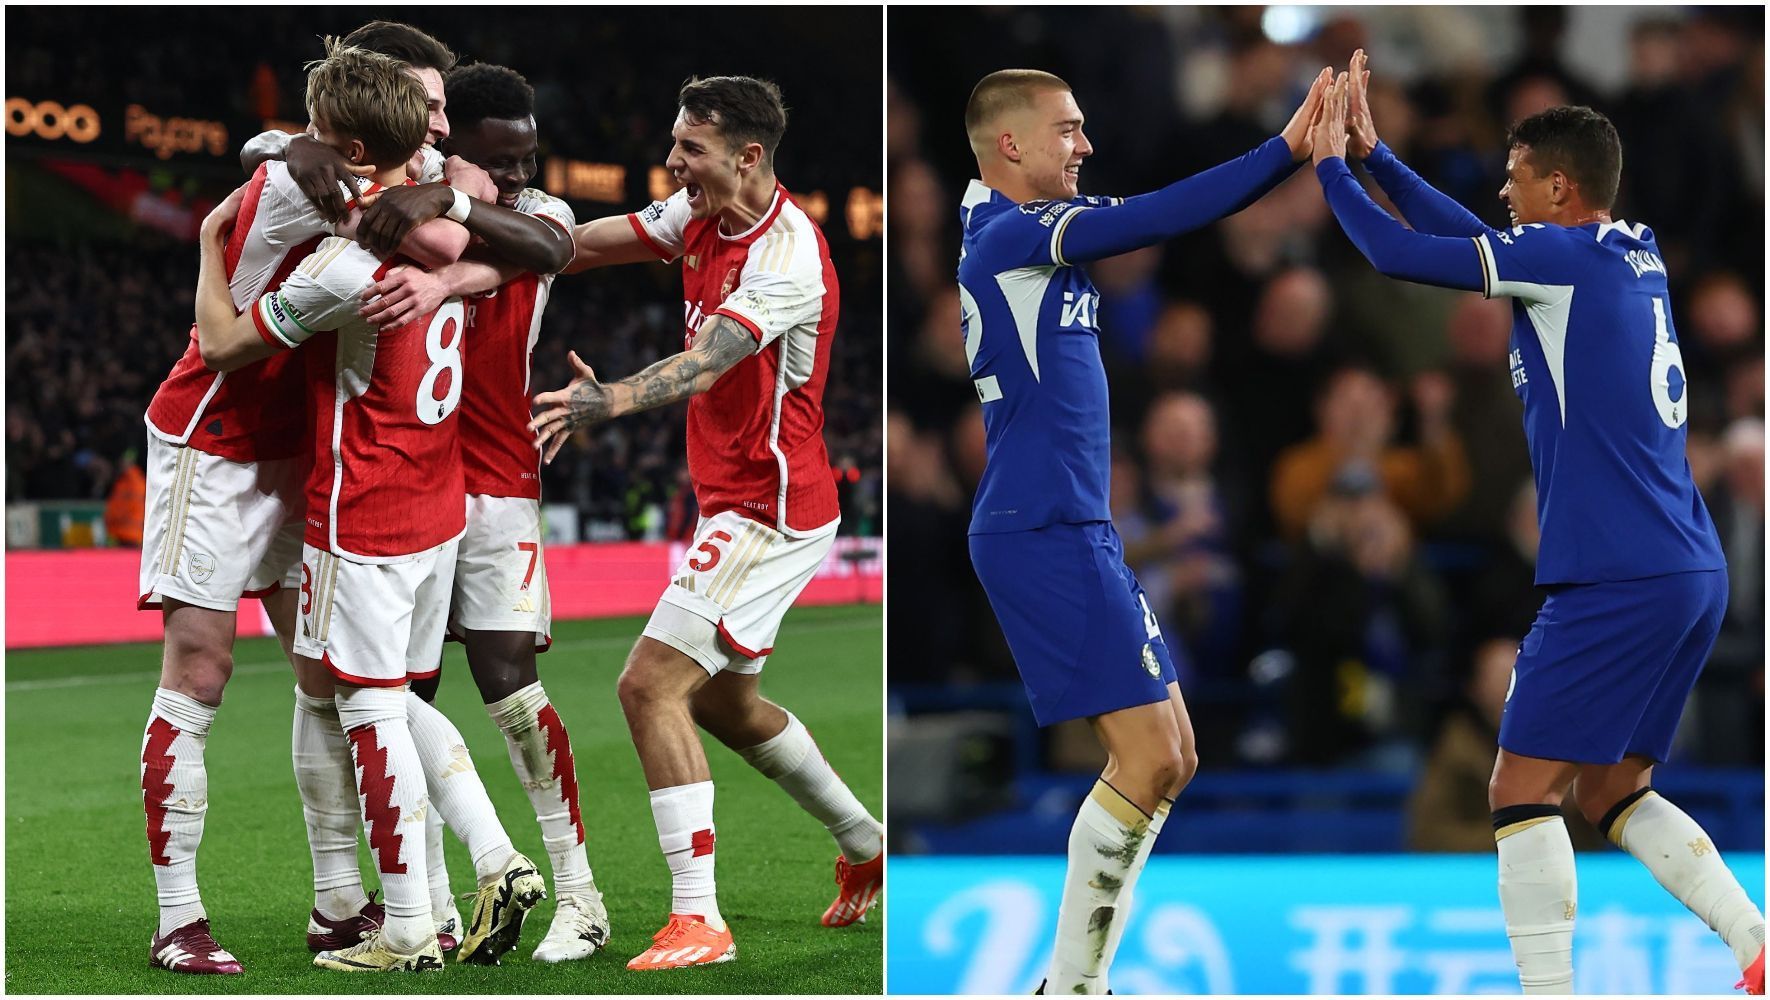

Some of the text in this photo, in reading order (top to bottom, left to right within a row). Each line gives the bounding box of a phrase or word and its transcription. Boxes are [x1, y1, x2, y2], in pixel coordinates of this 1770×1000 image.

[416, 301, 465, 425] 8
[1651, 297, 1688, 429] 6
[517, 541, 538, 591] 7
[689, 530, 732, 572] 5
